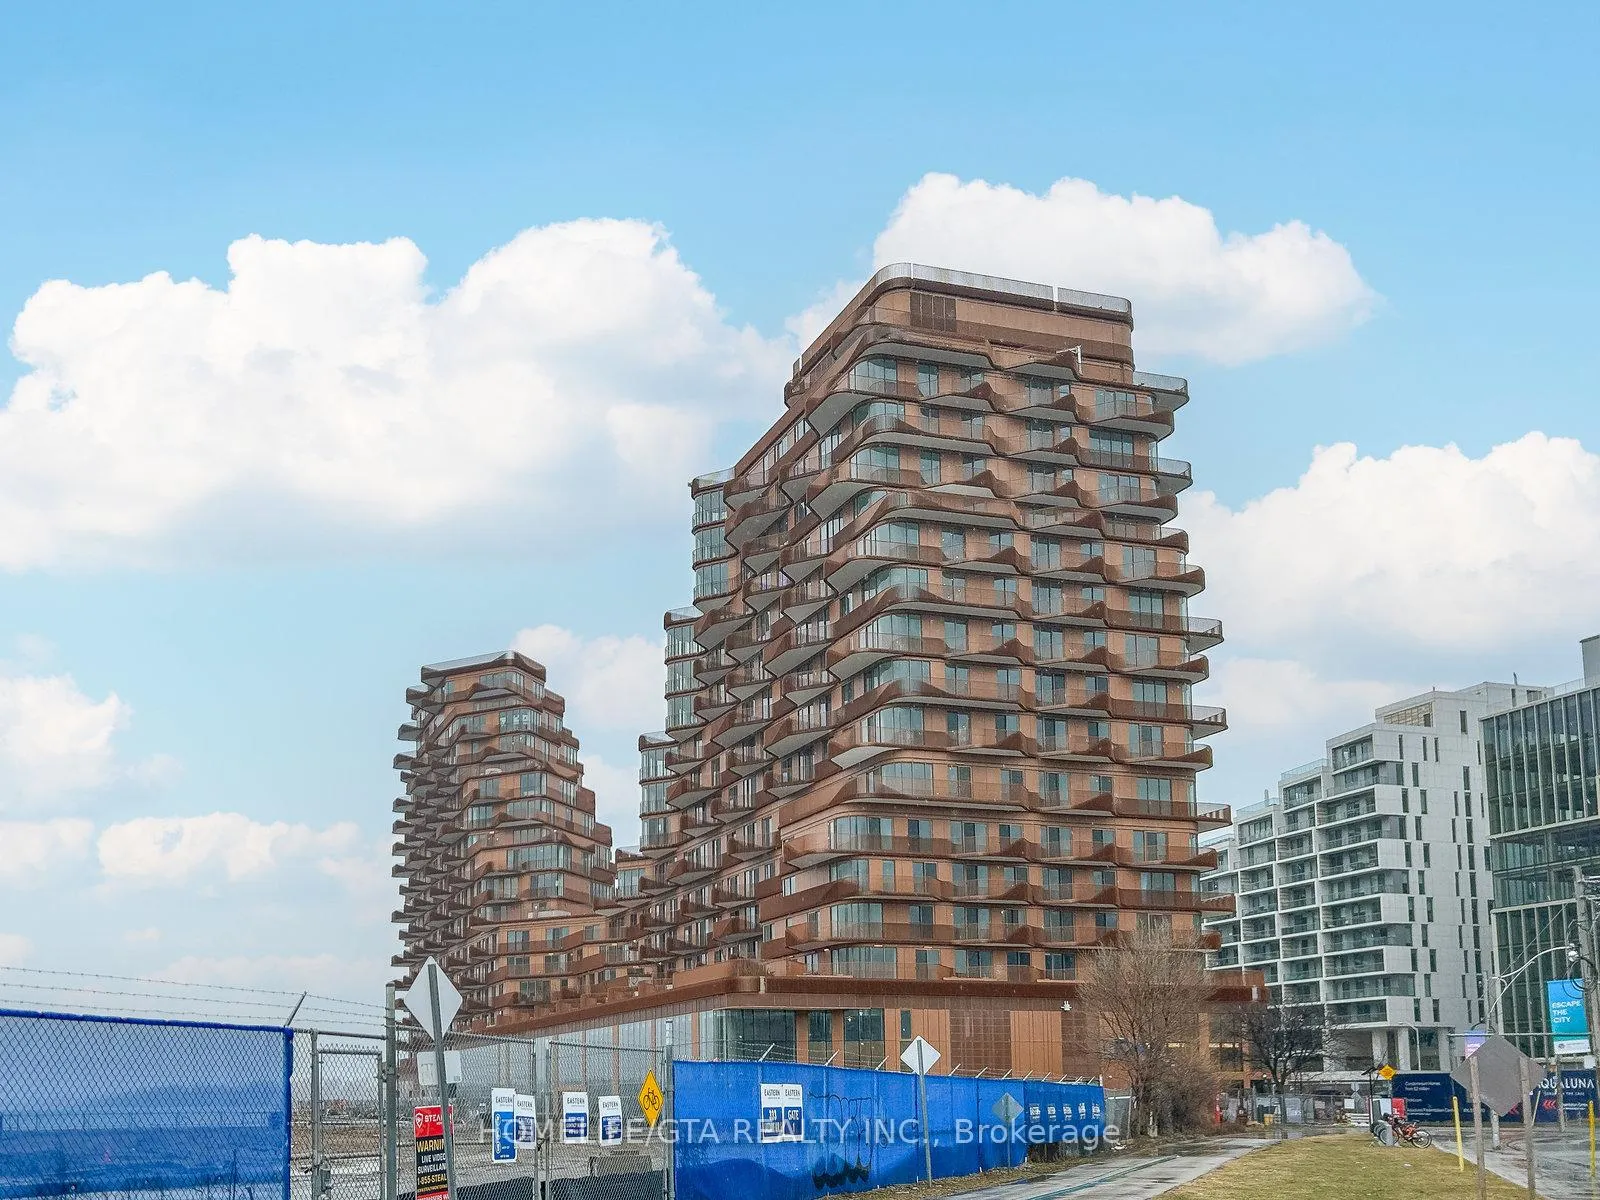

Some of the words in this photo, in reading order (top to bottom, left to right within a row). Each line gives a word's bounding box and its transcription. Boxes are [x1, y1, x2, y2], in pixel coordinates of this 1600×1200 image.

[1551, 1001, 1582, 1009] ESCAPE
[1553, 1016, 1571, 1024] CITY
[1537, 1077, 1595, 1090] QULUNA
[764, 1088, 781, 1097] EASTERN
[784, 1089, 801, 1097] EASTERN
[495, 1096, 513, 1104] EASTERN
[516, 1100, 533, 1108] EASTERN
[566, 1097, 585, 1105] EASTERN
[602, 1101, 619, 1109] EASTERN
[787, 1109, 799, 1121] GATE
[416, 1138, 445, 1153] WARNI
[421, 1154, 432, 1164] LIVE
[417, 1162, 447, 1175] SURVEILLAN
[417, 1173, 447, 1186] 1-855-STEAL
